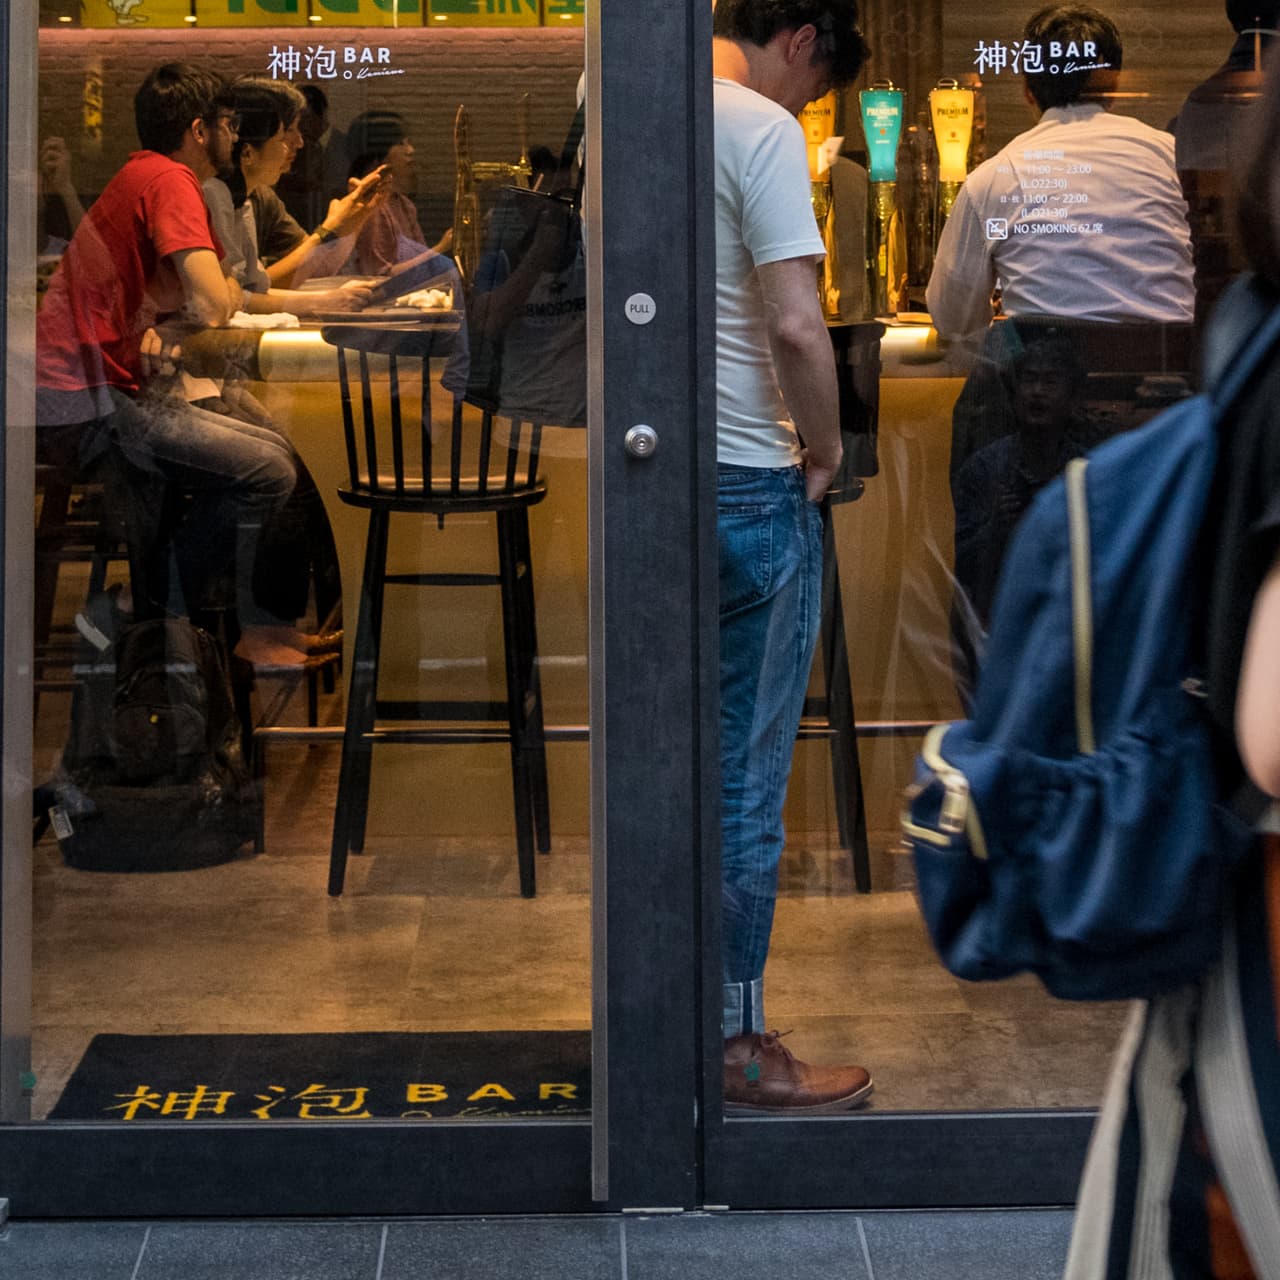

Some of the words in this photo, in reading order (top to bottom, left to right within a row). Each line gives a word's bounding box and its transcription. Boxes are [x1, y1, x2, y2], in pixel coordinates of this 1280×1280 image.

[344, 47, 391, 64] BAR
[1049, 41, 1097, 58] BAR
[1014, 224, 1029, 234] NO
[1031, 224, 1077, 234] SMOKING
[630, 304, 650, 313] PULL
[406, 1083, 577, 1103] BAR
